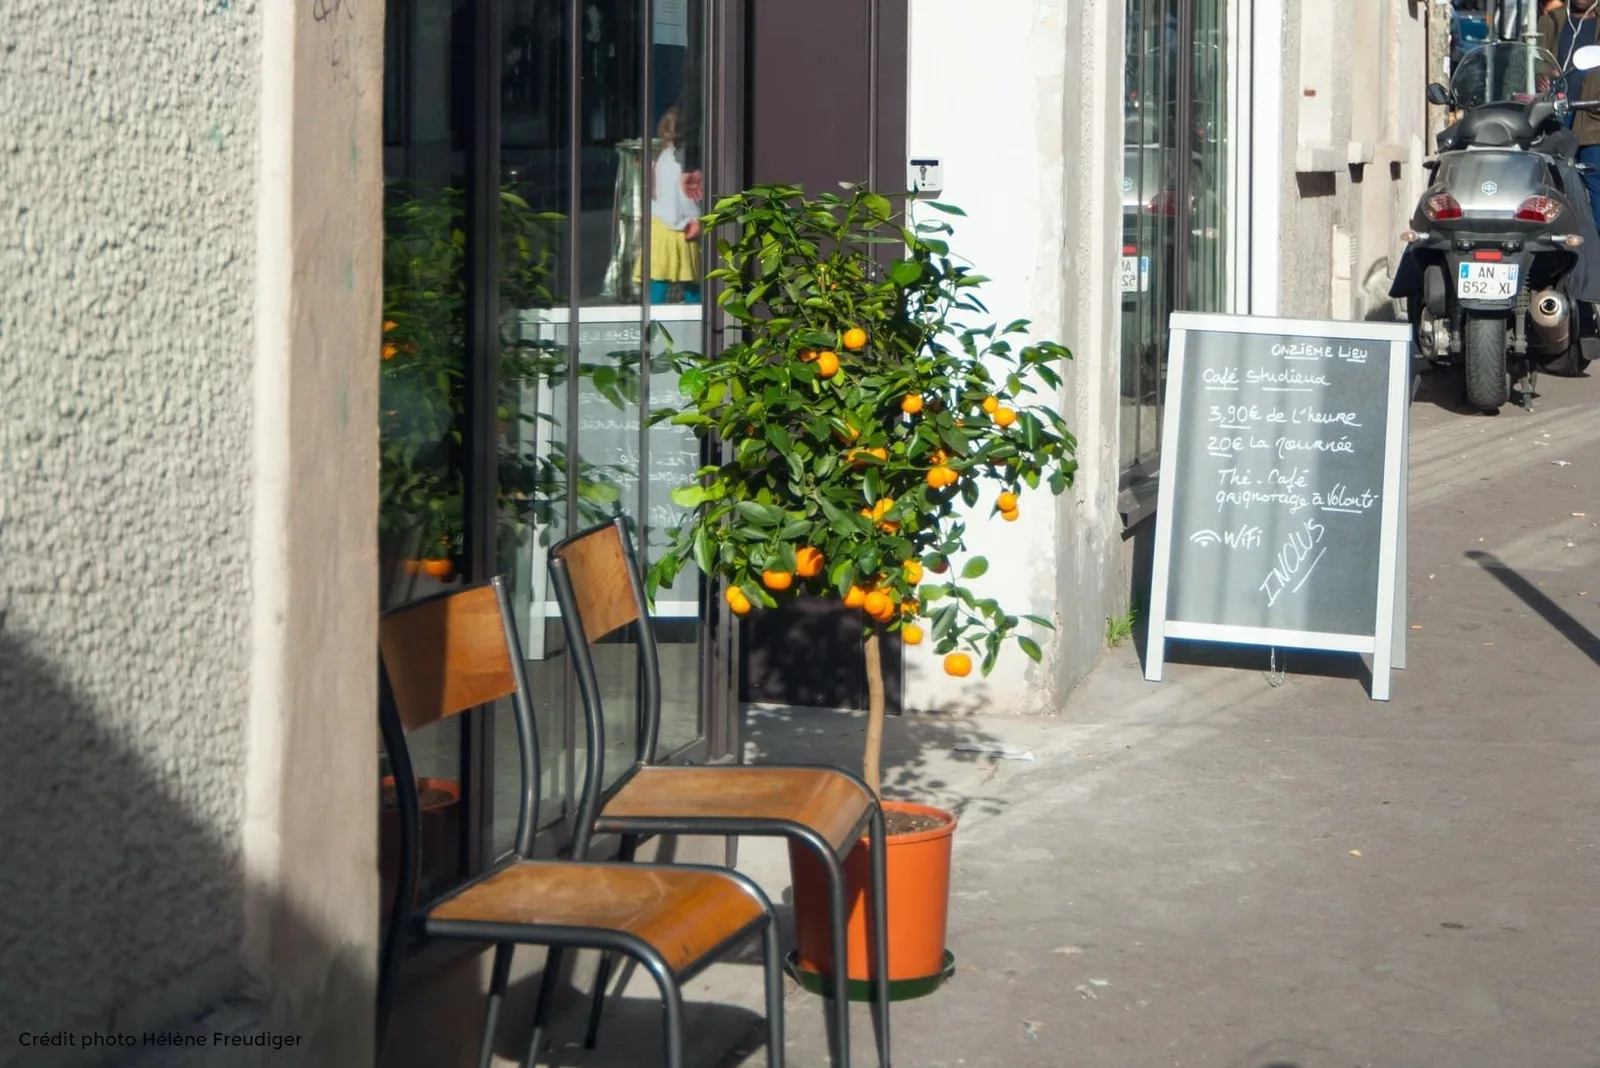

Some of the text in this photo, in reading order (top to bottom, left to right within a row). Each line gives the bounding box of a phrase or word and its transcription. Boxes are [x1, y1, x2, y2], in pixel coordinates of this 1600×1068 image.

[1478, 266, 1495, 278] AN
[1463, 281, 1488, 293] 652
[1208, 406, 1261, 425] 3,90€
[1266, 407, 1287, 423] de
[1207, 436, 1244, 451] 20€
[1224, 524, 1262, 549] WiFi
[1259, 518, 1325, 607] INCLUS
